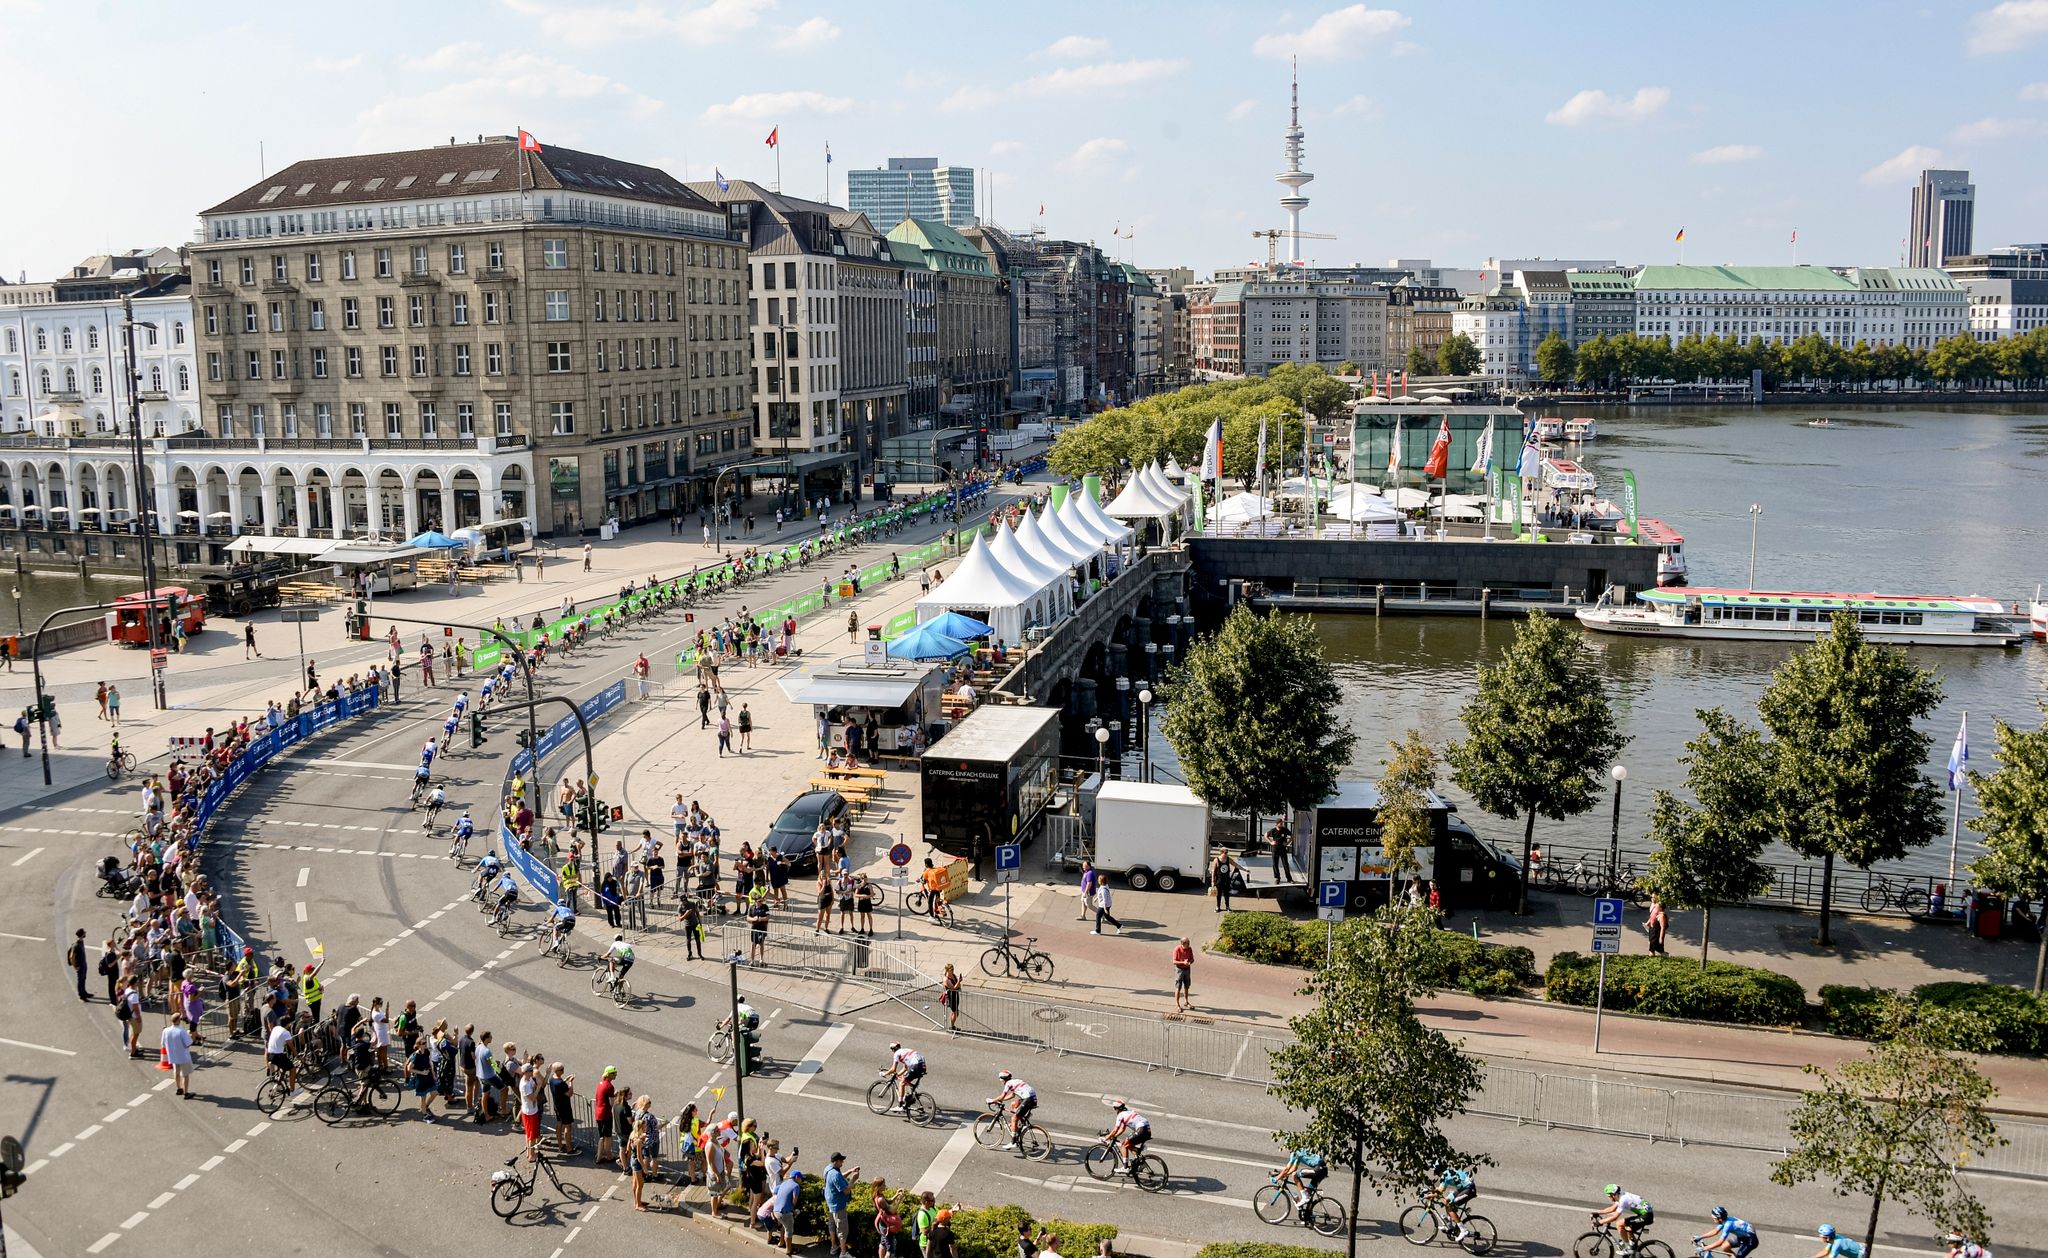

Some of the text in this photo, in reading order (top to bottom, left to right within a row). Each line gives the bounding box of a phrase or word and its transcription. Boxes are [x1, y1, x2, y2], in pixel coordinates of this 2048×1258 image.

[957, 346, 995, 357] ALSTRHAUS
[980, 420, 987, 428] S
[312, 704, 337, 720] EuroEyes
[929, 769, 955, 777] CATERING
[1321, 828, 1364, 836] CATERING
[1001, 848, 1015, 867] P
[1325, 885, 1340, 904] P
[1599, 902, 1614, 921] P
